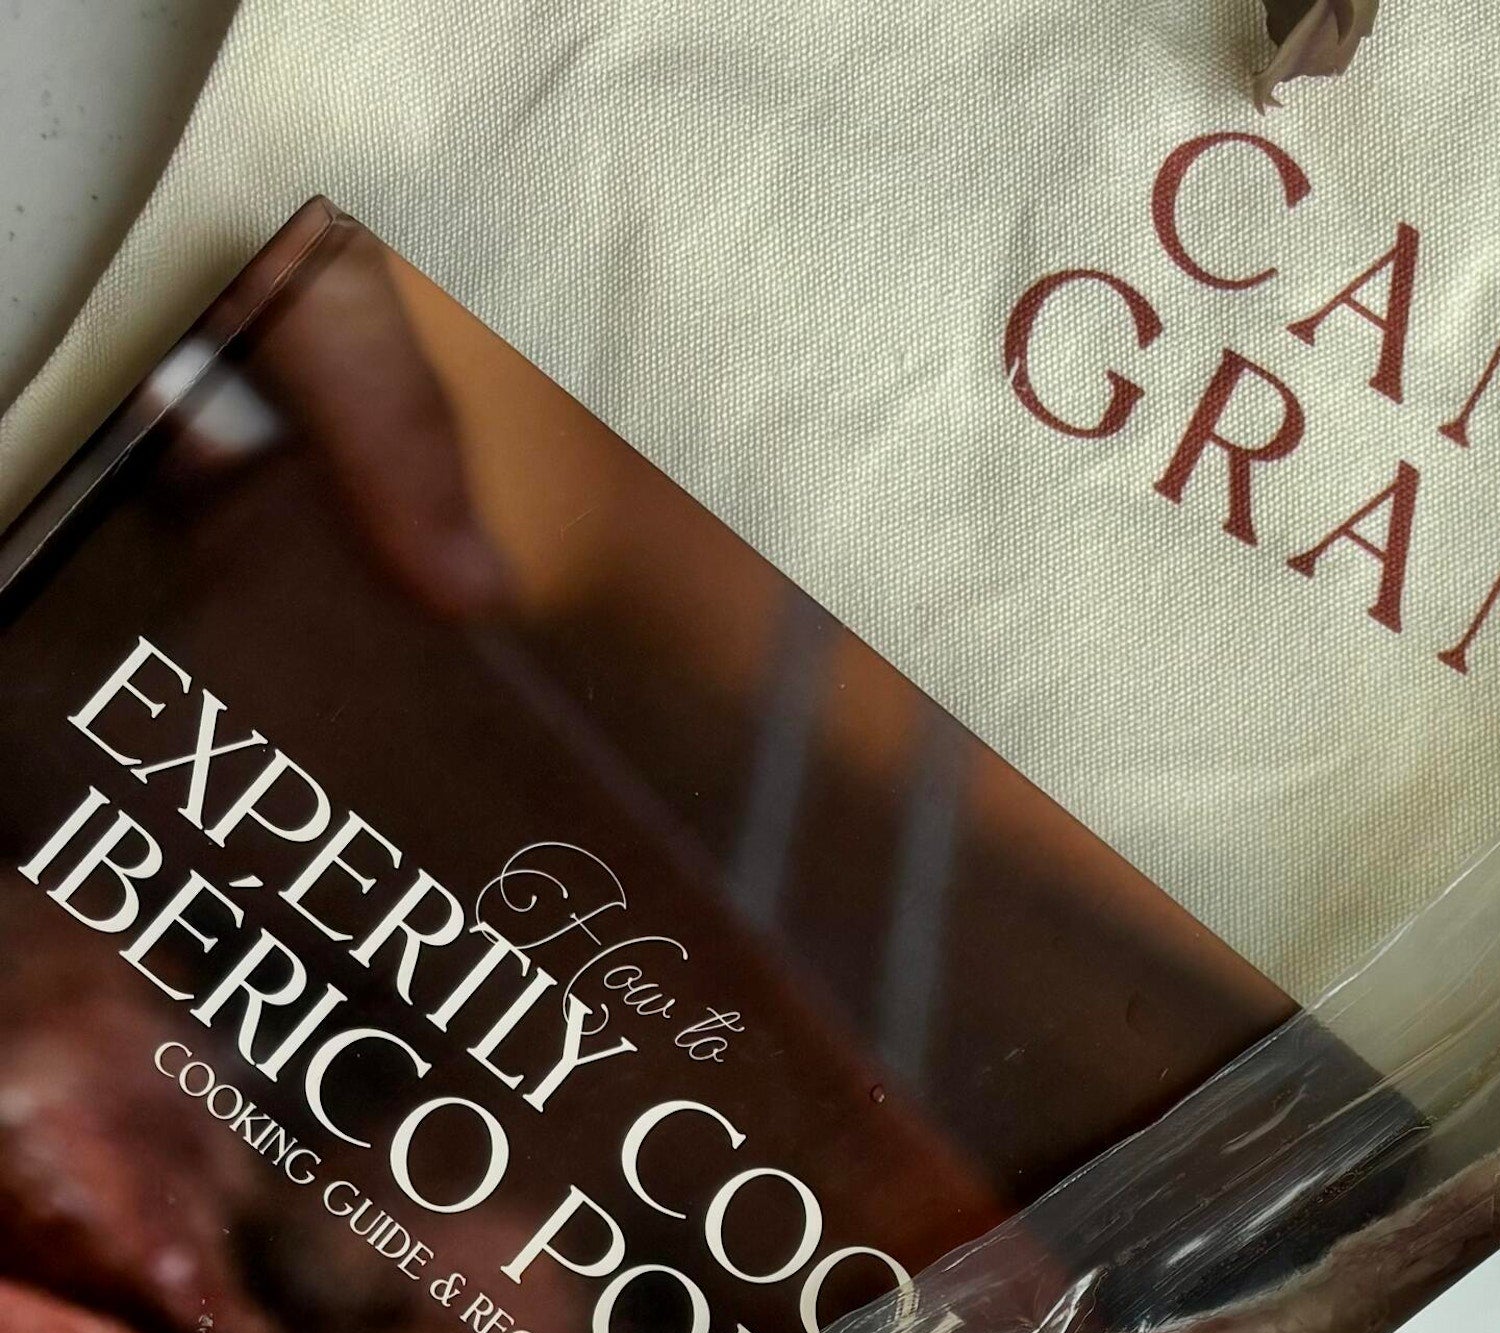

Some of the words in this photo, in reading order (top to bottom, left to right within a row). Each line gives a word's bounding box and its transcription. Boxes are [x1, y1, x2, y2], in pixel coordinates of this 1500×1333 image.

[17, 786, 510, 1213] IBÉRICO
[68, 635, 638, 1113] EXPERTLY
[675, 1006, 745, 1065] to
[153, 1041, 321, 1185] COOKING
[322, 1180, 435, 1284] GUIDE
[430, 1272, 468, 1308] &
